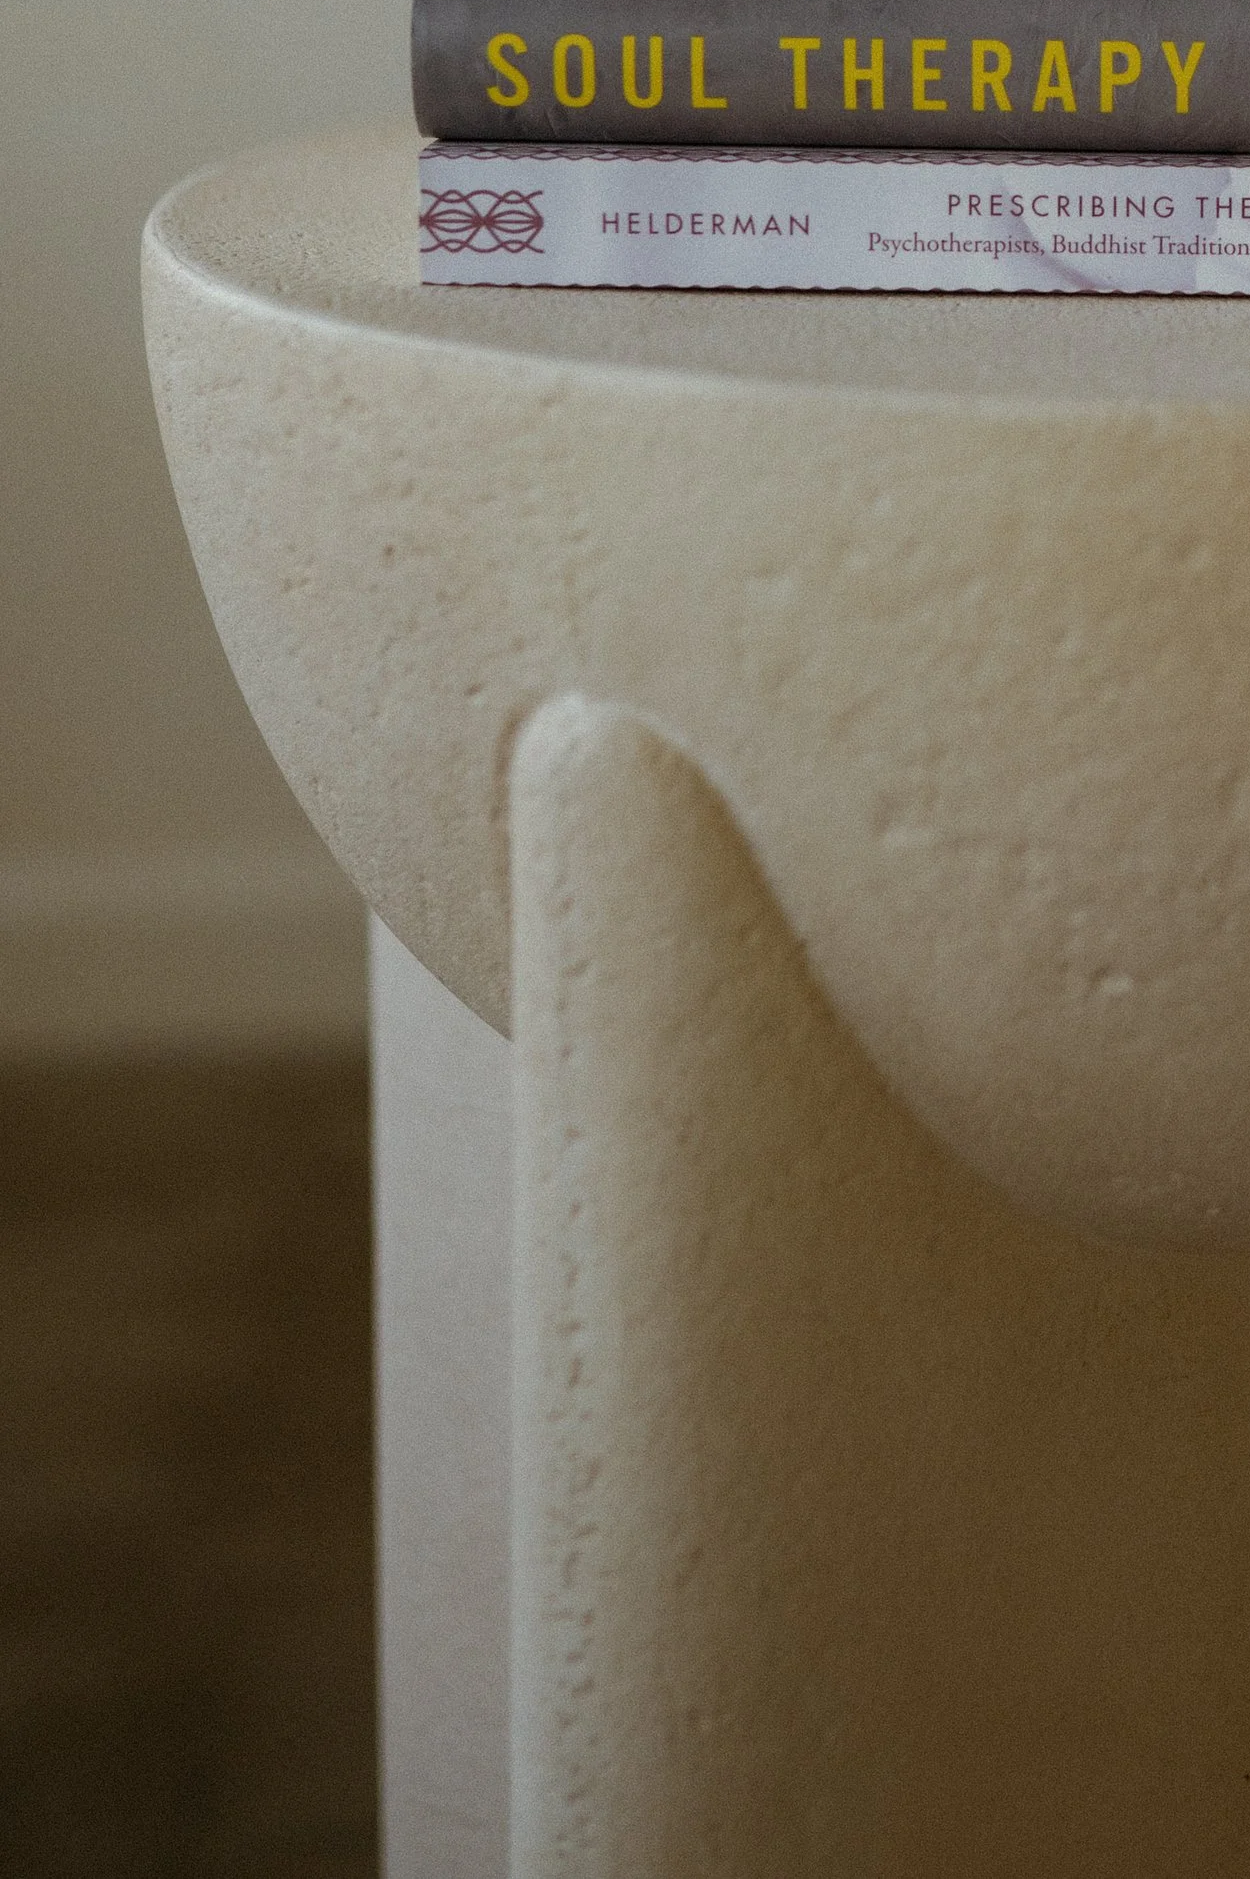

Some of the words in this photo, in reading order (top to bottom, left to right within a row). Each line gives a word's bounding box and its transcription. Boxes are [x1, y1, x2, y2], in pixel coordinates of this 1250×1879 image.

[487, 33, 727, 110] SOUL
[780, 38, 1205, 113] THERAPY
[948, 193, 1175, 219] PRESCRIBING
[601, 212, 811, 235] HELDERMAN
[868, 232, 1045, 259] Psychotherapists,
[1052, 234, 1147, 255] Buddhist
